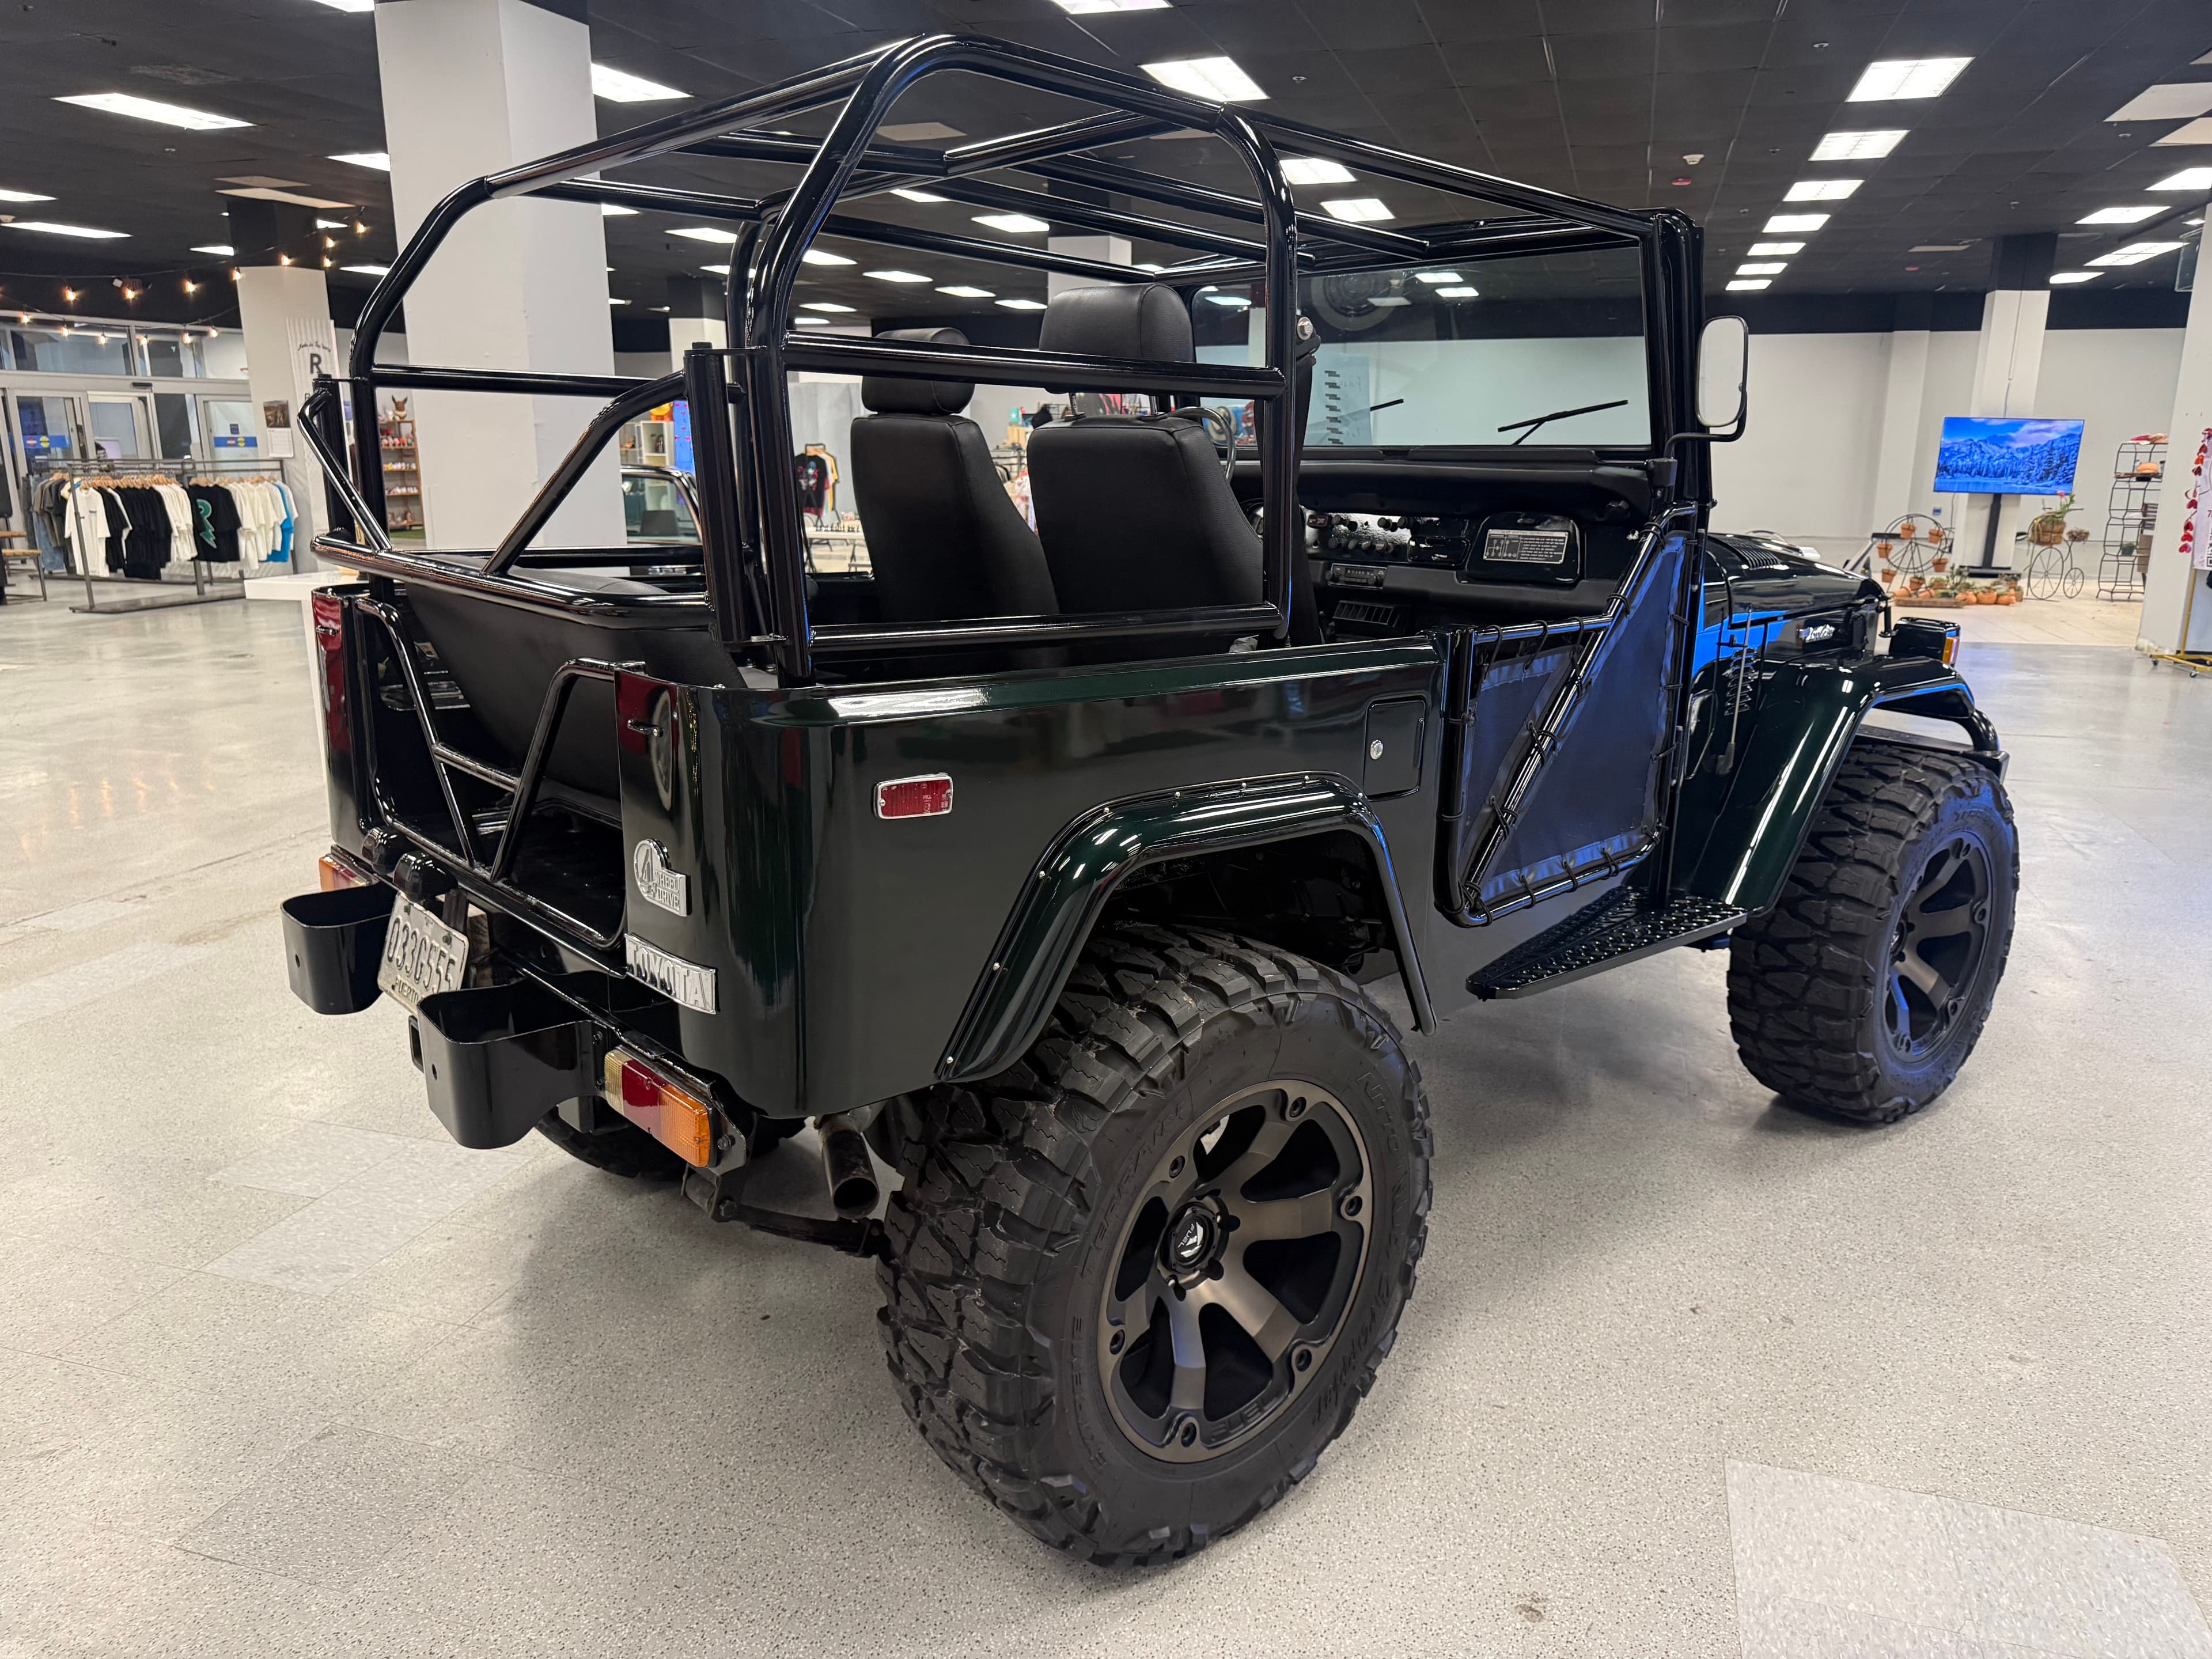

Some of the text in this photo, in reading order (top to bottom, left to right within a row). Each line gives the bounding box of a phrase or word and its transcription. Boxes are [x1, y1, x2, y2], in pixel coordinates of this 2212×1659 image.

[639, 847, 657, 893] 4
[655, 870, 680, 893] WHEEL
[657, 887, 680, 908] DRIVE
[628, 941, 707, 1009] TOYOTA
[1177, 1224, 1195, 1248] FUEL
